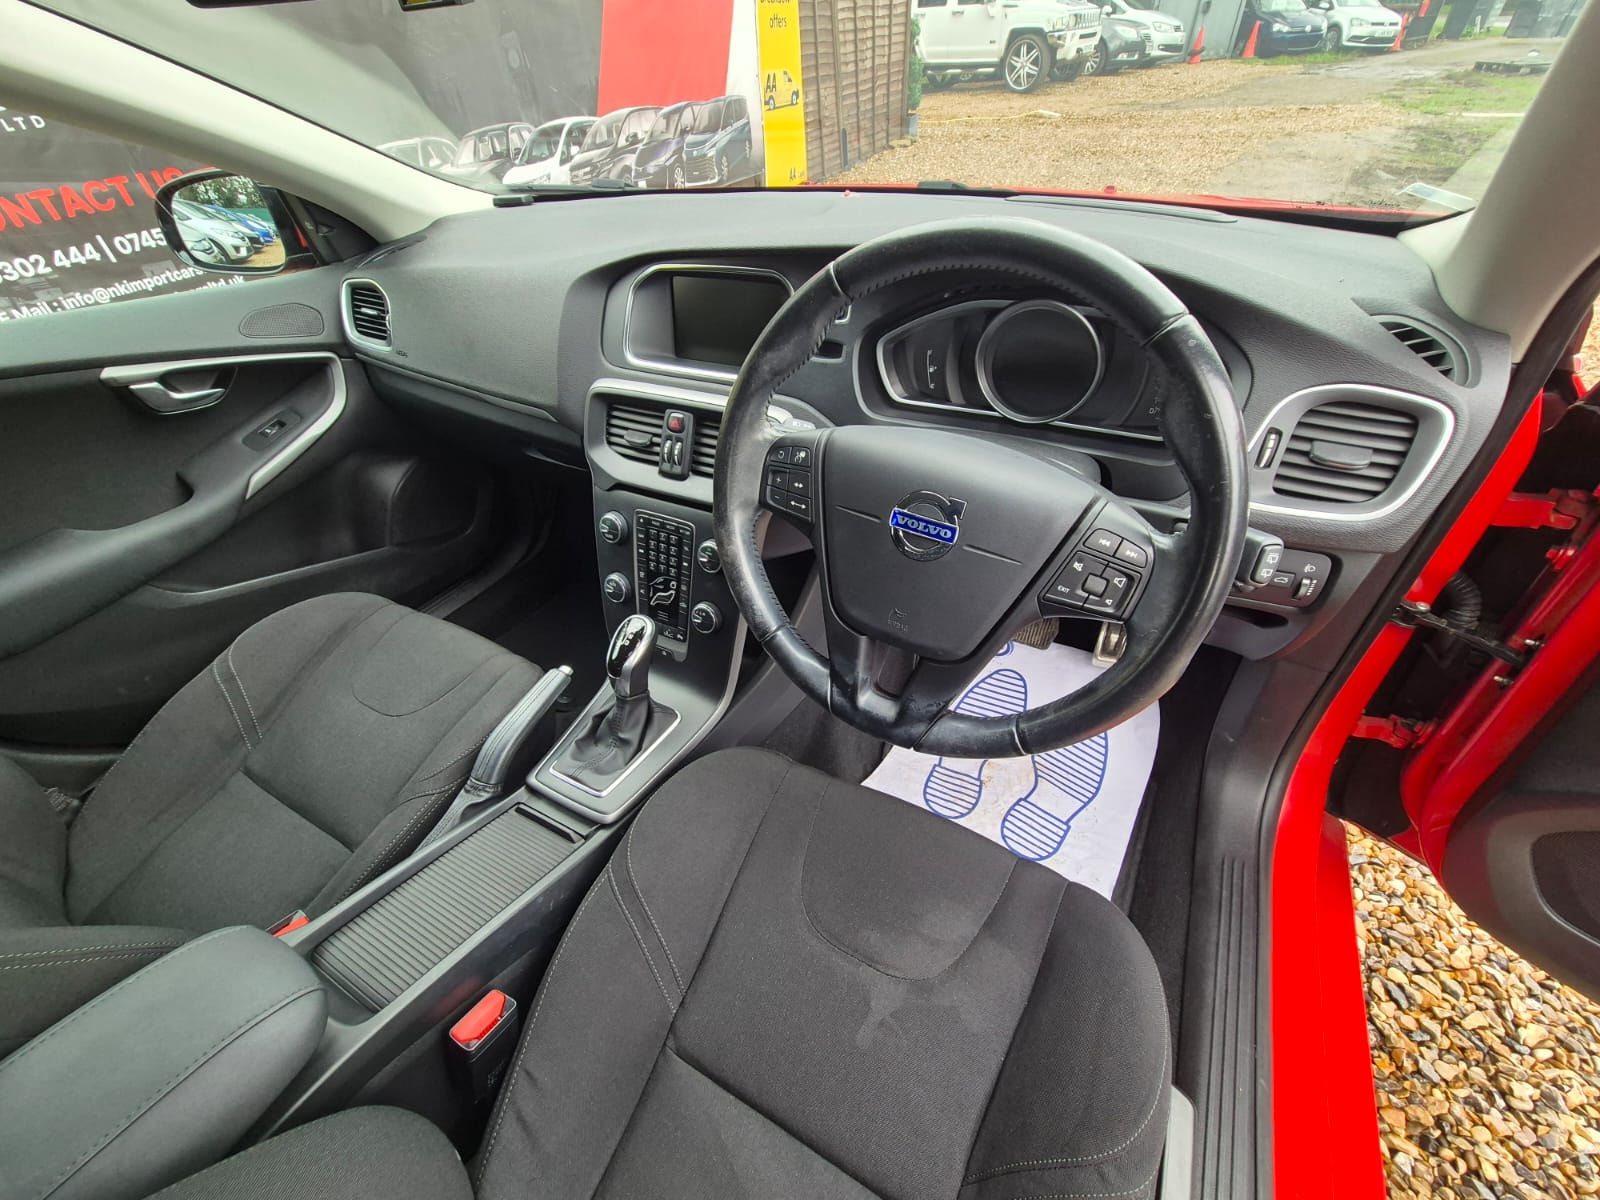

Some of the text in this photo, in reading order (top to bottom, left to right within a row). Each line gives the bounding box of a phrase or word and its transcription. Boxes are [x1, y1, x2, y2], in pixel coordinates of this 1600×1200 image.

[765, 71, 777, 94] AA
[0, 115, 46, 132] LTD
[0, 176, 135, 232] NTACT
[0, 254, 53, 284] 302
[53, 242, 102, 268] 444
[896, 514, 952, 538] VOLVO
